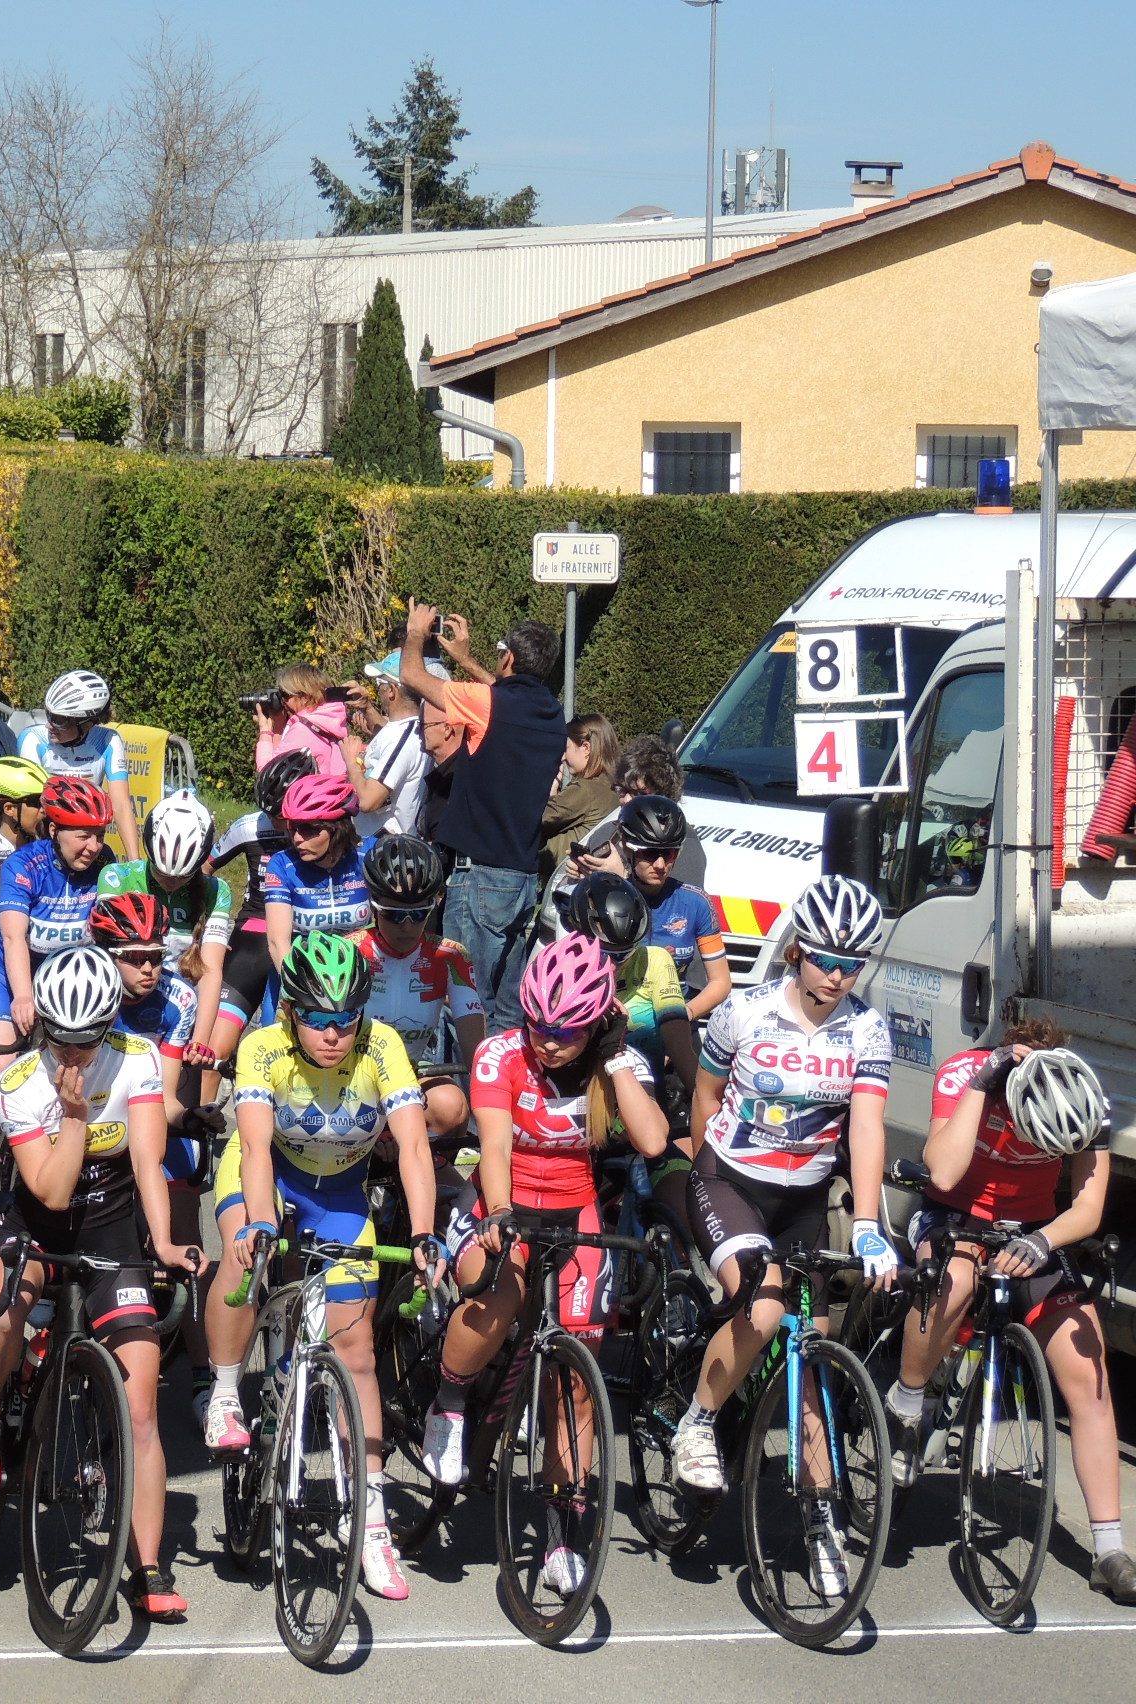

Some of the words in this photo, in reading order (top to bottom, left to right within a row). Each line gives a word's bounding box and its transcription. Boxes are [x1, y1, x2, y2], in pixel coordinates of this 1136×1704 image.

[572, 542, 601, 555] ALLÉE
[539, 562, 549, 573] de
[551, 562, 558, 573] la
[561, 561, 612, 574] FRATERNITÉ
[843, 587, 949, 601] CROIX-ROUGE
[948, 590, 1007, 608] FRANÇA
[808, 638, 841, 692] 8
[807, 731, 843, 783] 4
[29, 923, 82, 942] YPER
[293, 910, 351, 926] HYPER
[885, 962, 907, 985] MULTI
[907, 969, 942, 993] SERVICES
[0, 1054, 37, 1086] VELOLAND
[750, 1042, 856, 1078] Géant
[294, 1116, 326, 1126] CLUB
[703, 1211, 725, 1243] VÉLO
[571, 1276, 588, 1317] Chazal
